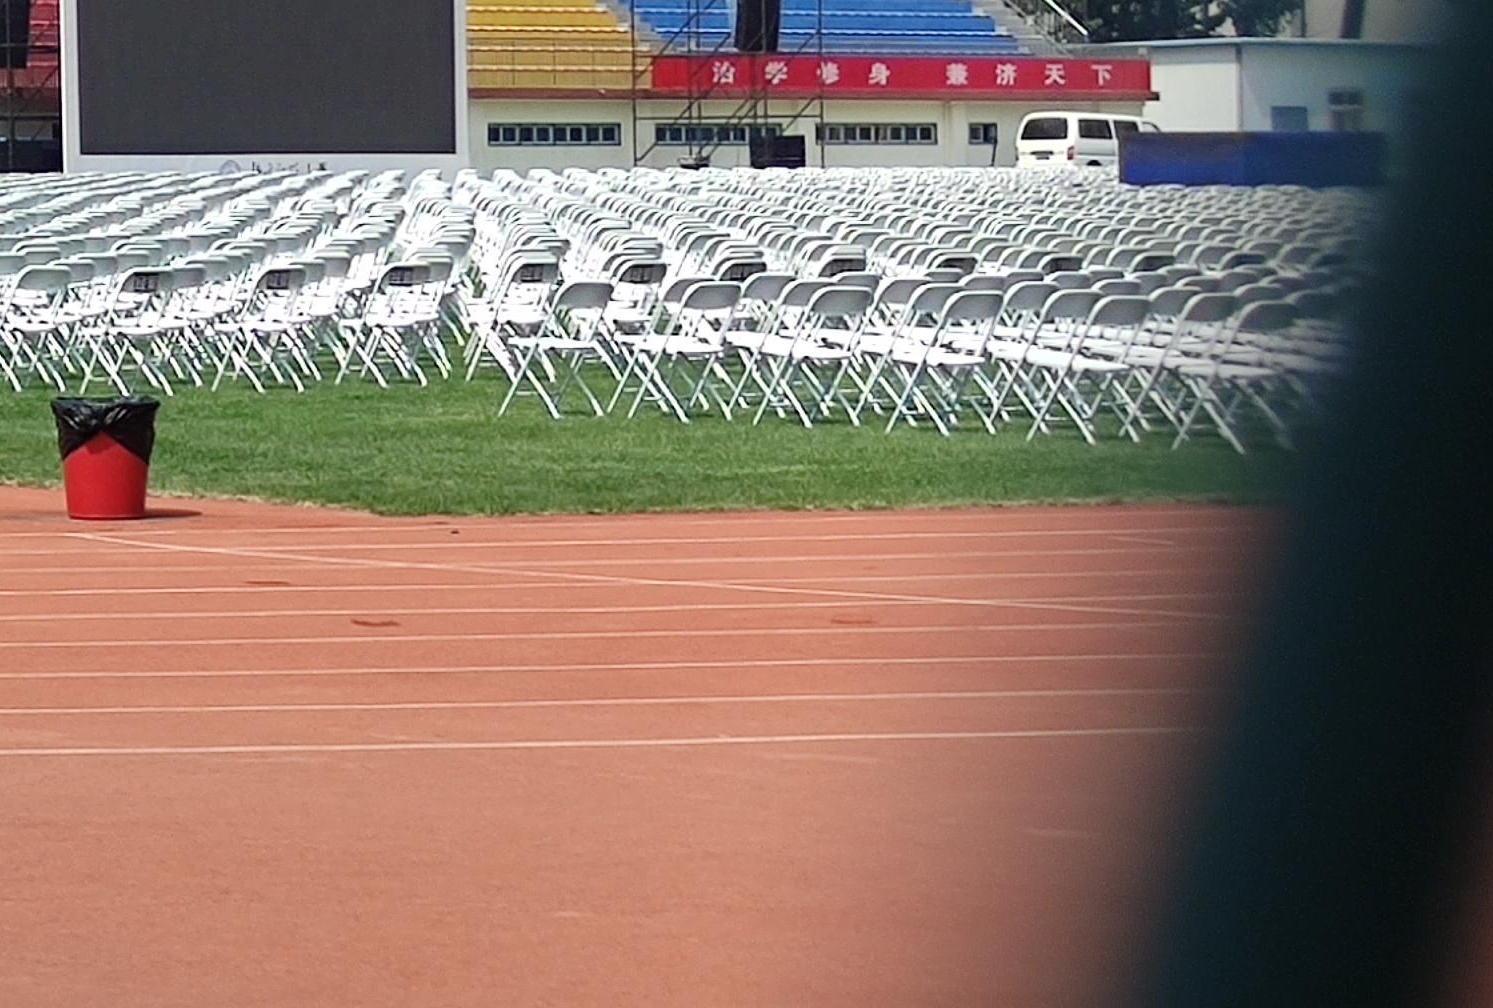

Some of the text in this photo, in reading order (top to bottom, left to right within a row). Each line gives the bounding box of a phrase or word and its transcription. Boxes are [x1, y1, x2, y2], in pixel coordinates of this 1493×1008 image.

[713, 61, 1112, 85] 治学修身 兼济天下
